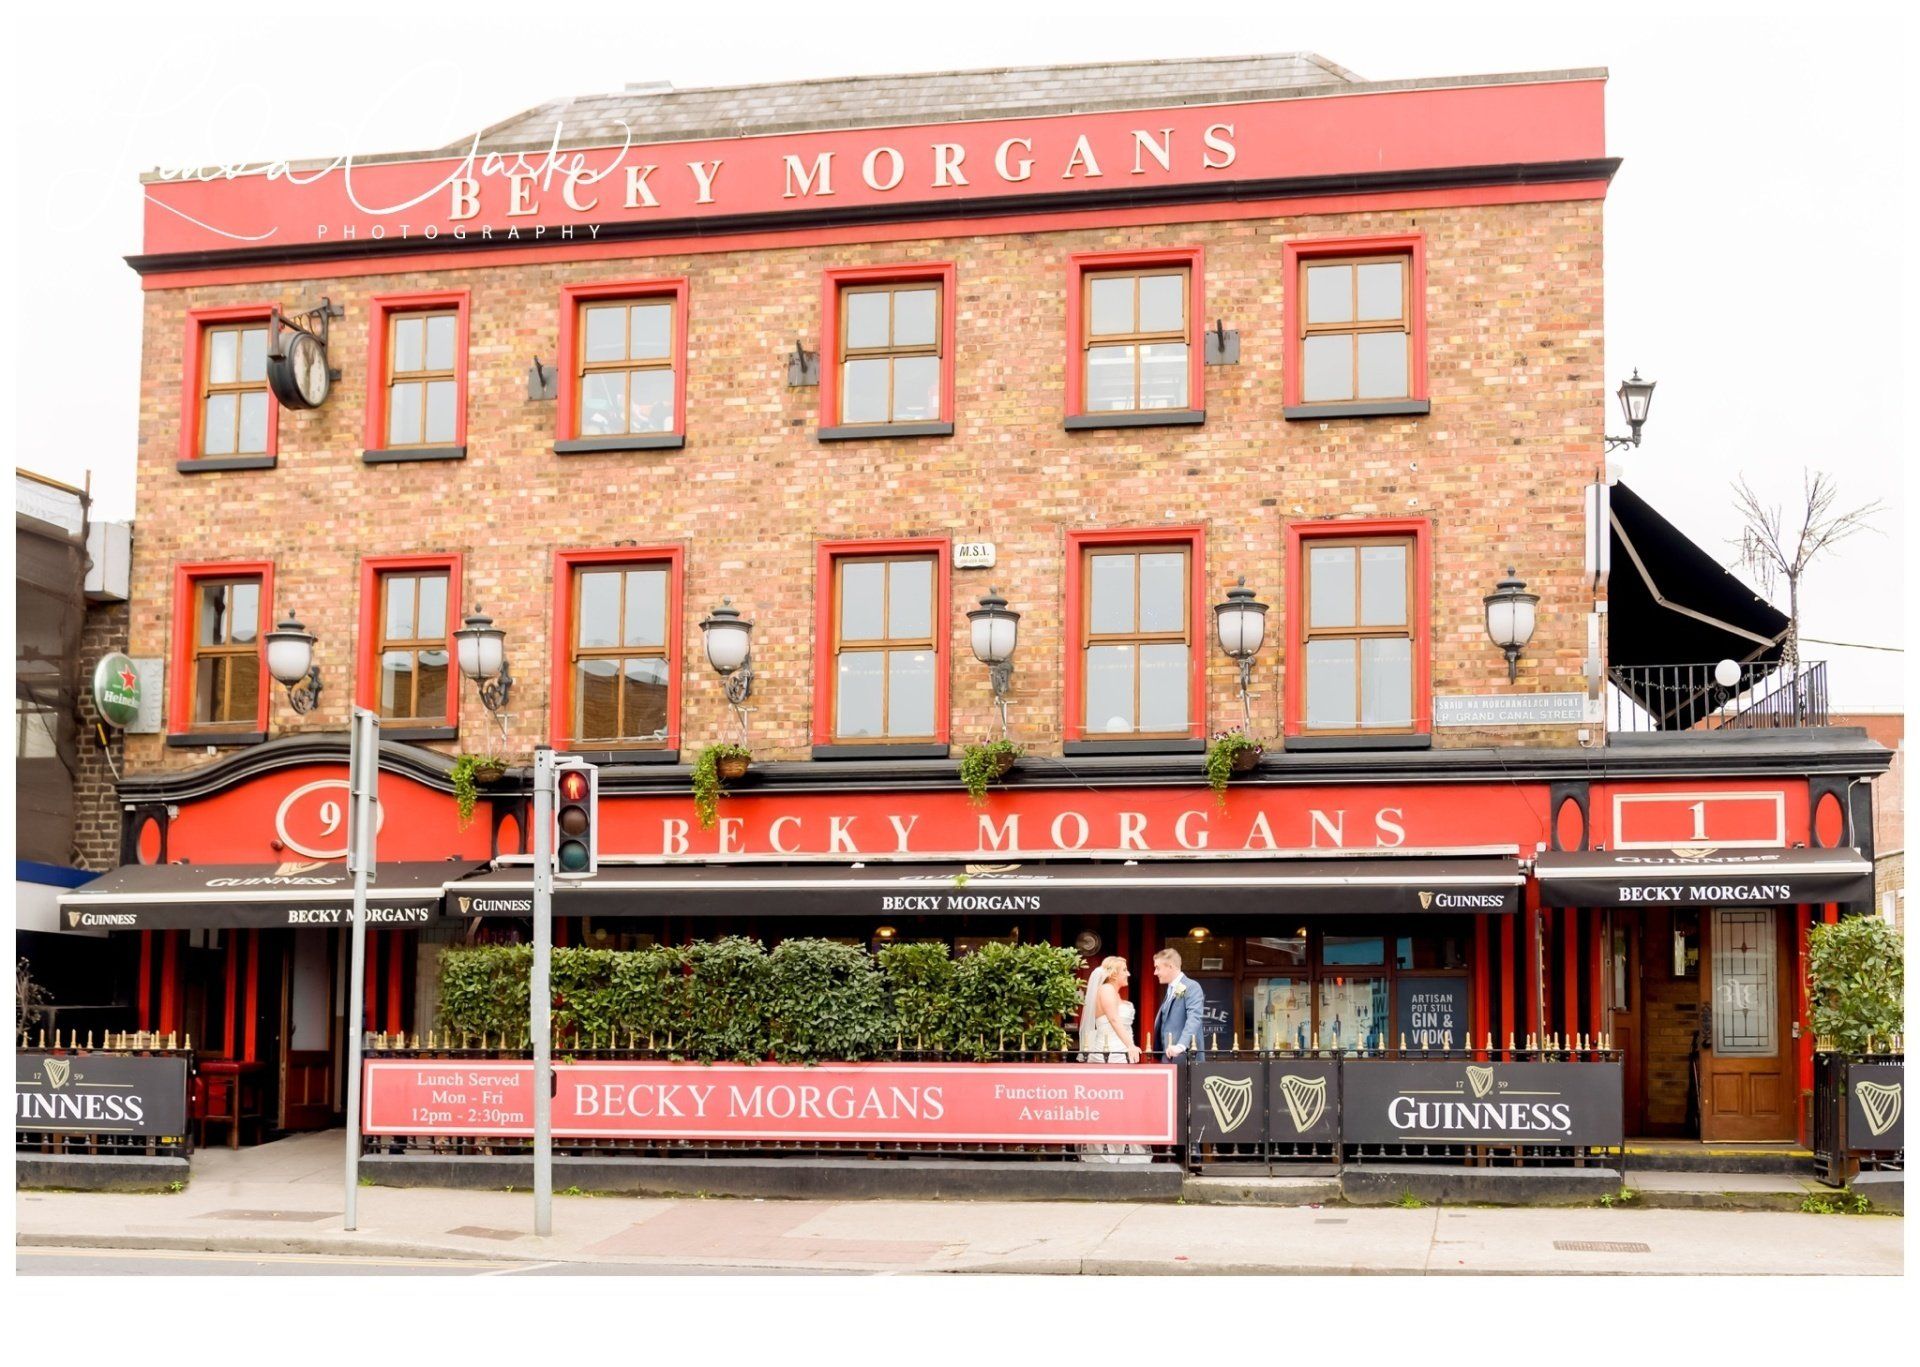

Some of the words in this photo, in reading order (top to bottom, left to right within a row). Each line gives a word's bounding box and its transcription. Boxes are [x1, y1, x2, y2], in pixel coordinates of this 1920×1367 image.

[448, 160, 723, 221] BECKY
[783, 123, 1237, 199] MORGANS
[1456, 711, 1495, 722] GRAND
[1499, 710, 1535, 721] CANAL
[1540, 709, 1582, 720] STREET
[319, 801, 341, 837] 9
[1687, 801, 1708, 841] 1
[662, 815, 919, 856] BECKY
[978, 808, 1407, 853] MORGANS
[1614, 854, 1777, 864] GUINNESS
[206, 876, 340, 887] GUINNESS
[1435, 893, 1504, 907] GUINNESS
[1618, 886, 1684, 902] BECKY
[1689, 885, 1791, 900] MORGAN'S
[473, 898, 532, 911] GUINNESS
[882, 896, 942, 910] BECKY
[947, 896, 1041, 910] MORGAN'S
[81, 913, 137, 926] GUINNESS
[288, 909, 341, 924] BECKY
[1411, 994, 1453, 1003] ARTISAN
[1411, 1004, 1428, 1012] POT
[1430, 1004, 1453, 1012] STILL
[1411, 1012, 1438, 1028] GIN
[1443, 1013, 1453, 1028] &
[417, 1072, 464, 1087] Lunch
[468, 1072, 519, 1087] Served
[431, 1090, 467, 1105] Mon
[482, 1090, 504, 1105] Fri
[994, 1084, 1068, 1099] Function
[1074, 1085, 1124, 1100] Room
[16, 1092, 144, 1122] INNESS
[573, 1083, 717, 1117] BECKY
[727, 1084, 945, 1121] MORGANS
[411, 1108, 452, 1124] 12pm
[468, 1108, 524, 1125] 2:30pm
[1018, 1105, 1101, 1121] Available
[1387, 1096, 1572, 1131] GUINNESS
